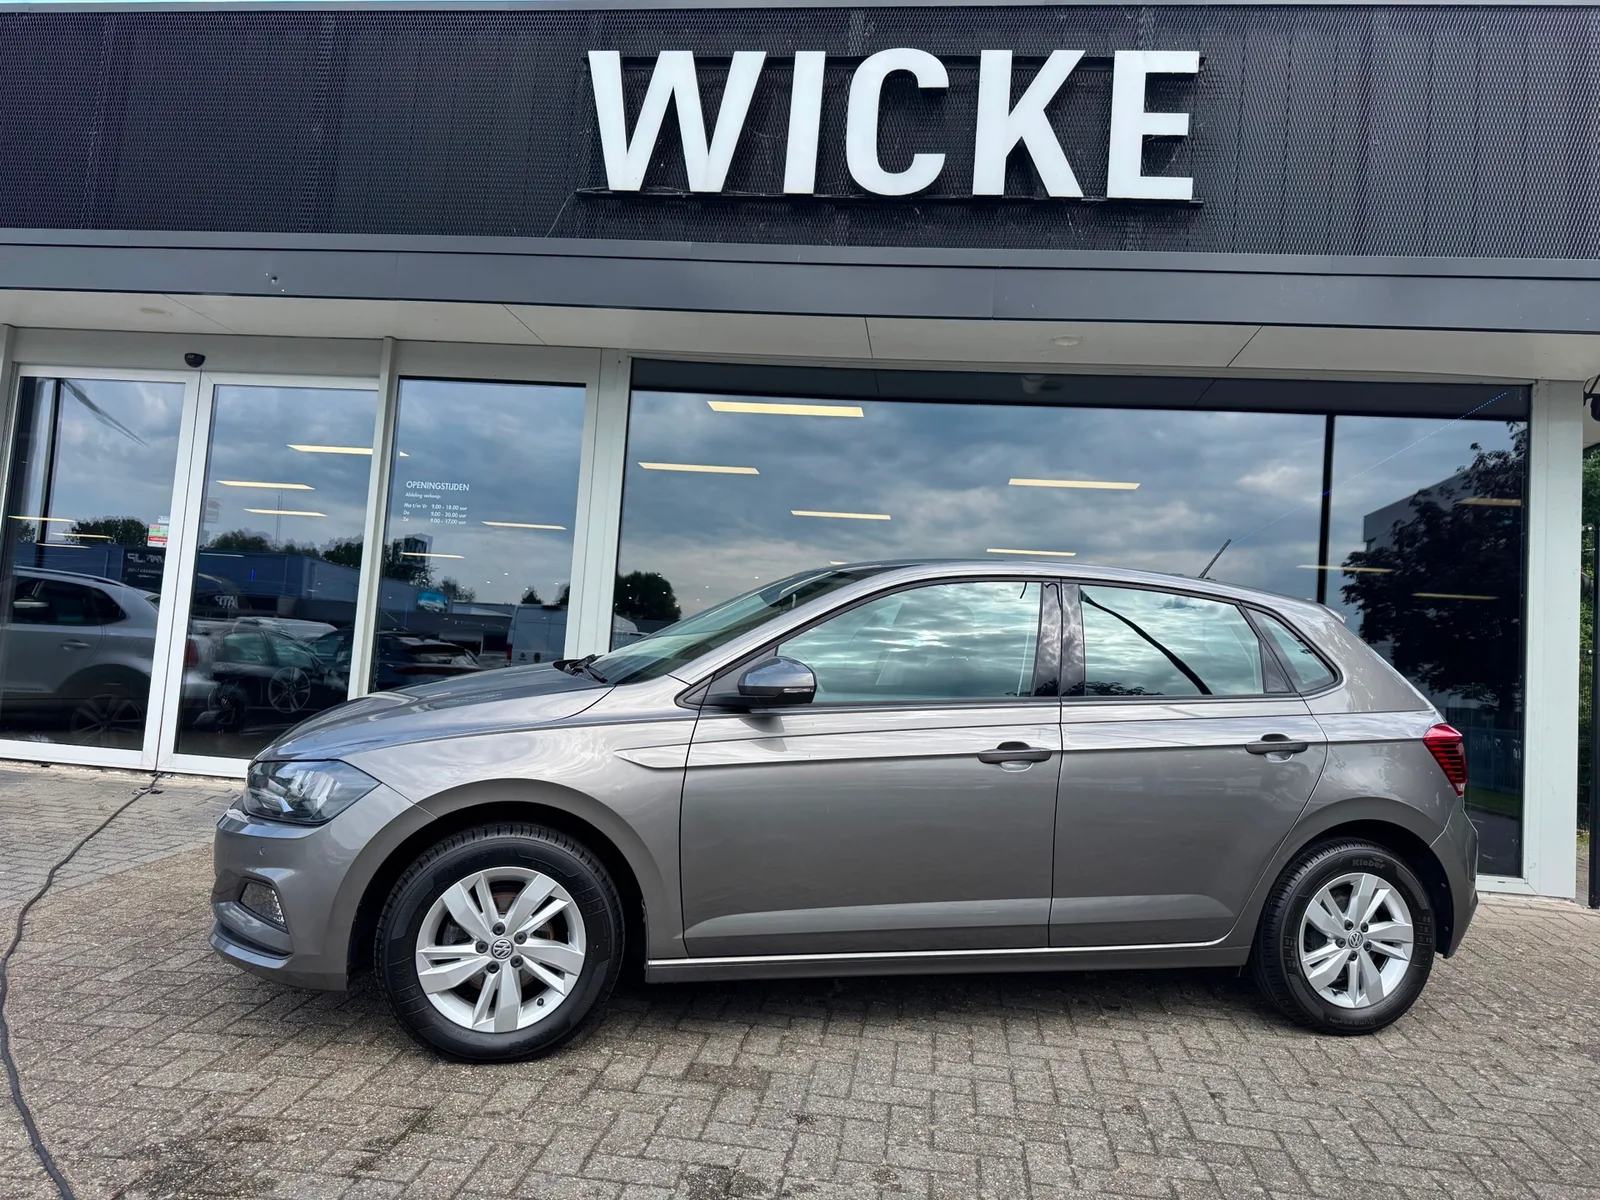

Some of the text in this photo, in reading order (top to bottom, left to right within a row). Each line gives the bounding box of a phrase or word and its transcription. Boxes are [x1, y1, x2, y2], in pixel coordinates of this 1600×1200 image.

[587, 47, 1200, 198] WICKE
[406, 481, 470, 491] OPENINGSTIJDEN
[1352, 859, 1386, 869] Kleber
